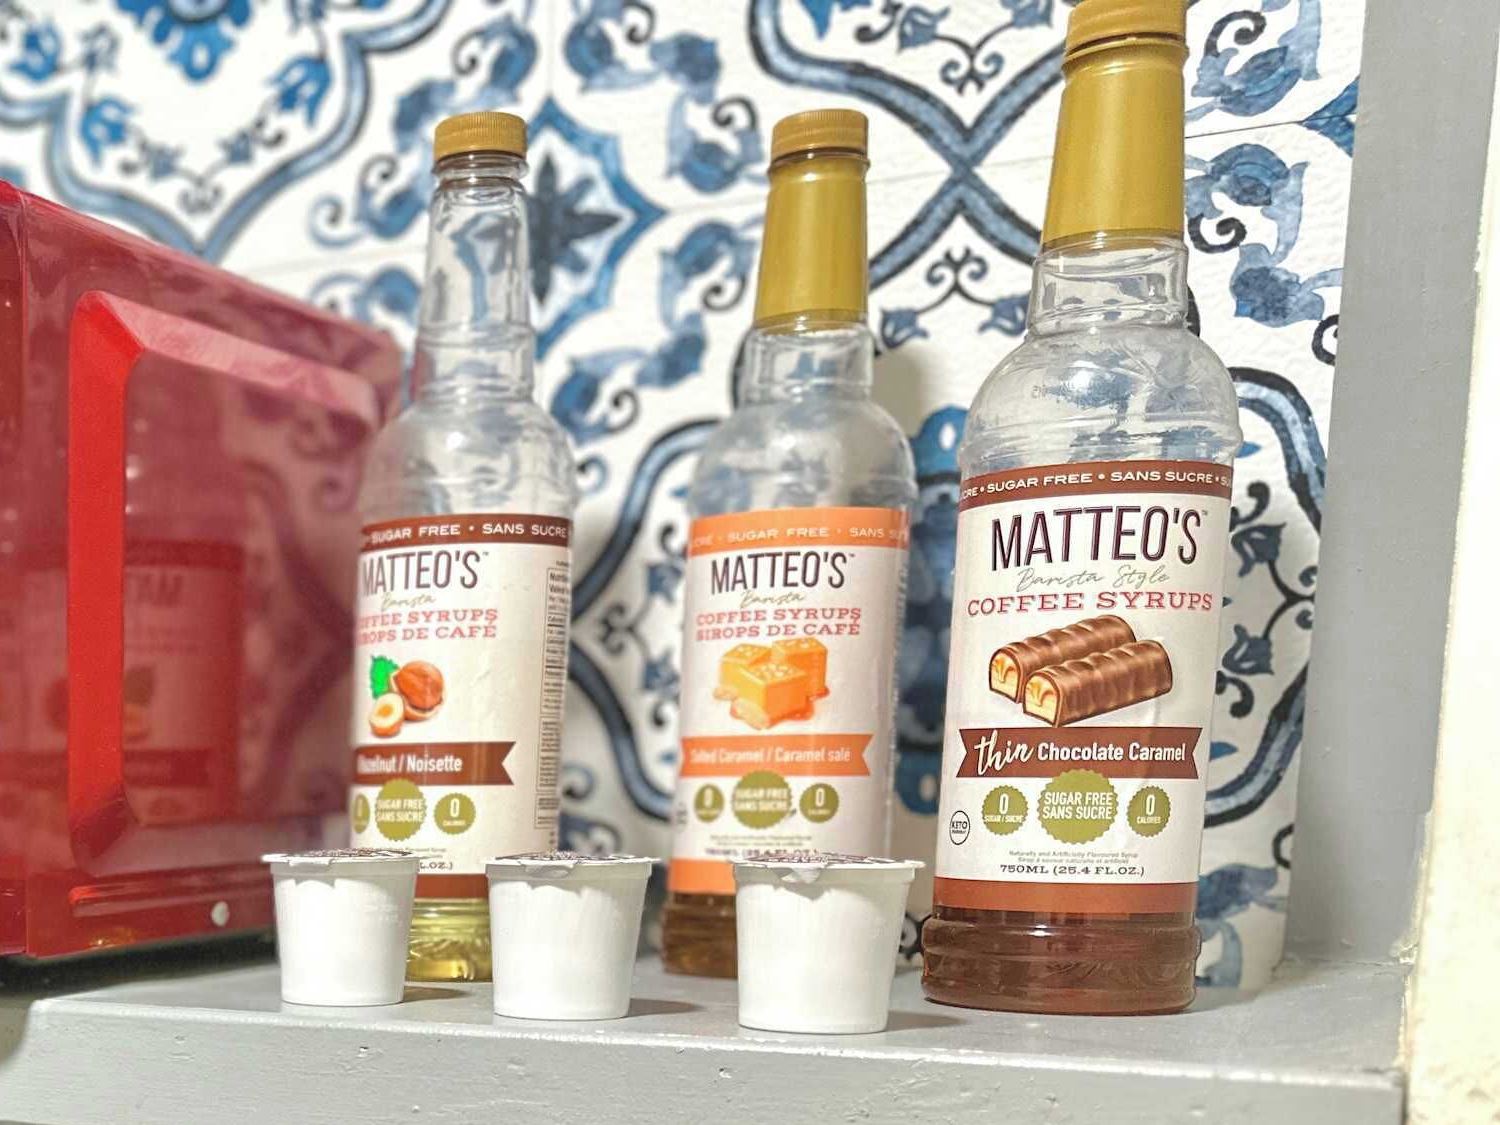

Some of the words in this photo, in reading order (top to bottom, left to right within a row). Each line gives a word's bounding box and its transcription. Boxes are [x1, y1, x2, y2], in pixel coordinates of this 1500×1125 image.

[987, 477, 1039, 493] SUGAR
[1043, 473, 1093, 484] FREE
[1111, 471, 1161, 482] SANS
[1165, 471, 1213, 484] SUCRE
[372, 527, 412, 544] SUGAR
[419, 524, 461, 537] FREE
[482, 523, 525, 535] SANS
[531, 524, 568, 538] SUCRE
[728, 529, 779, 544] SUGAR
[786, 526, 830, 538] FREE
[849, 527, 885, 538] SANS
[991, 506, 1201, 571] MATTEO'S
[710, 550, 848, 596] MATTEO'S
[1016, 568, 1102, 592] Barista
[1112, 565, 1169, 589] Style
[739, 591, 805, 609] Barista
[967, 592, 1085, 617] COFFEE
[1096, 591, 1213, 612] SYRUPS
[408, 608, 498, 625] SYRUPS
[696, 609, 767, 626] COFFEE
[773, 607, 861, 621] SYRUPS
[402, 627, 429, 641] DE
[696, 625, 760, 641] SIROPS
[767, 623, 797, 637] DE
[407, 752, 463, 773] Noisette
[775, 745, 825, 763] Caramel
[974, 729, 1034, 776] thin
[1037, 741, 1123, 761] Chocolate
[1129, 742, 1186, 761] Caramel
[815, 787, 825, 807] 0
[999, 793, 1008, 815] 0
[1044, 792, 1082, 805] SUGAR
[1085, 792, 1113, 805] FREE
[1145, 795, 1155, 815] 0
[450, 798, 460, 818] 0
[1042, 806, 1072, 819] SANS
[1075, 806, 1112, 819] SUCRE
[1000, 864, 1049, 875] 750ML
[1053, 864, 1091, 877] (25.4
